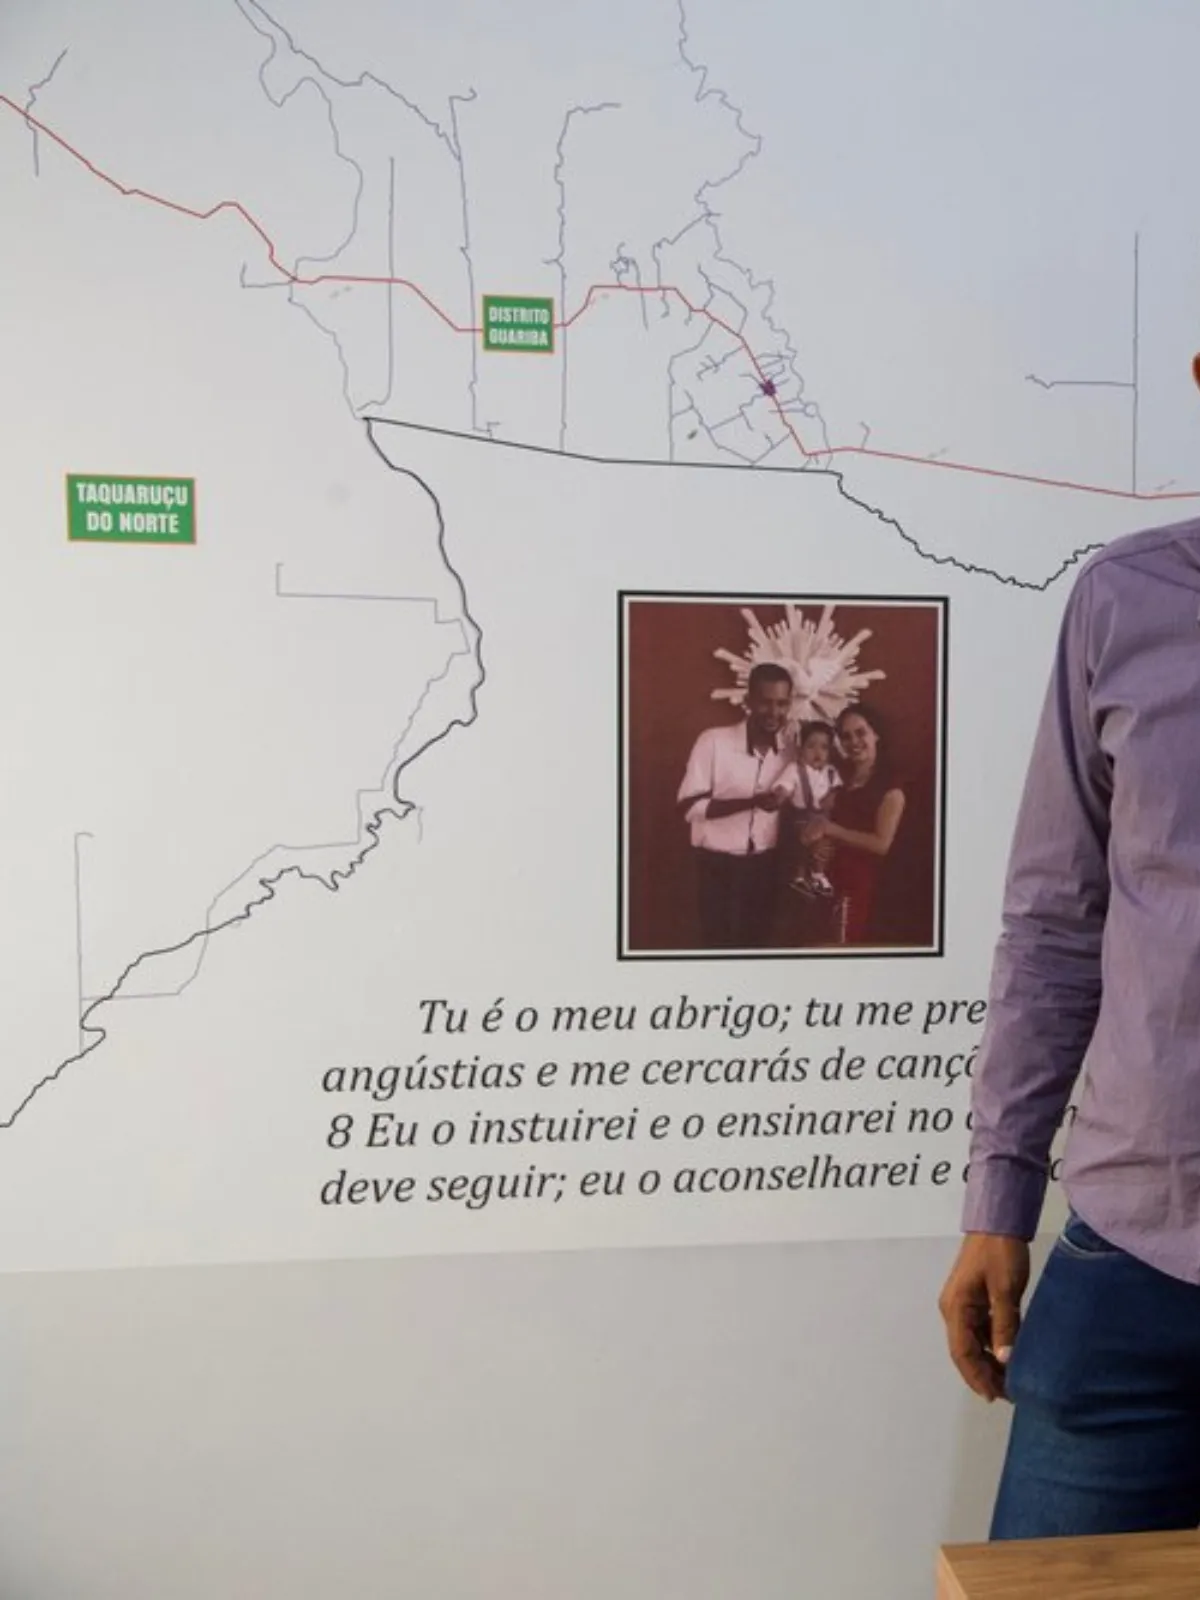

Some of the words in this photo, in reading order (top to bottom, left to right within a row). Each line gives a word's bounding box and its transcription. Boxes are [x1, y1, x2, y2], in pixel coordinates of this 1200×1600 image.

[488, 306, 550, 325] DISTRITO
[488, 328, 549, 346] GUARIBA
[76, 482, 188, 512] TAQUARUÇU
[86, 511, 113, 532] DO
[119, 512, 180, 534] NORTE
[419, 999, 469, 1034] Tu
[481, 997, 505, 1033] é
[515, 1005, 539, 1032] o
[552, 1004, 637, 1031] meu
[649, 994, 793, 1039] abrigo;
[805, 997, 844, 1028] tu
[856, 1000, 914, 1026] me
[322, 1054, 526, 1102] angústias
[536, 1060, 559, 1088] e
[570, 1060, 631, 1087] me
[642, 1047, 811, 1085] cercarás
[820, 1045, 866, 1081] de
[326, 1113, 354, 1149] 8
[365, 1112, 419, 1148] Eu
[432, 1119, 456, 1146] o
[469, 1107, 640, 1145] instuirei
[649, 1113, 671, 1140] e
[682, 1113, 705, 1139] o
[716, 1100, 898, 1138] ensinarei
[907, 1106, 954, 1133] no
[320, 1169, 416, 1205] deve
[426, 1165, 567, 1210] seguir;
[579, 1170, 626, 1197] eu
[638, 1169, 661, 1195] o
[673, 1153, 922, 1194] aconselharei
[930, 1159, 952, 1186] e
